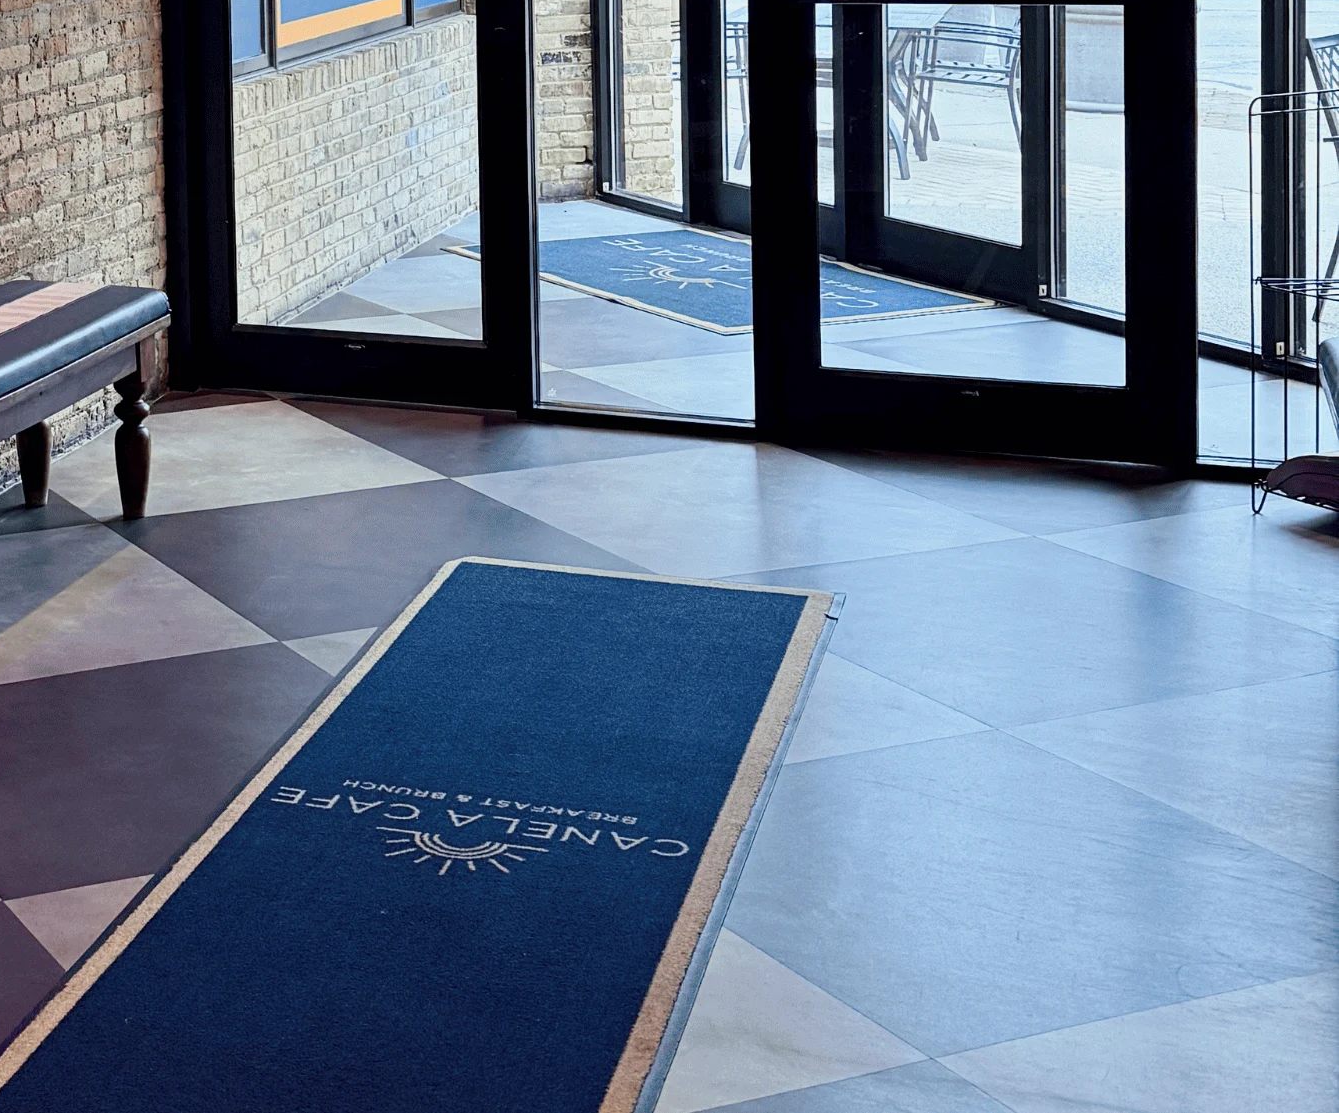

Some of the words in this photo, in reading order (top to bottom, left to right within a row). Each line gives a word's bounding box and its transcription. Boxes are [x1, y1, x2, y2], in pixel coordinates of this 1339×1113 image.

[270, 785, 421, 820] CAFE
[343, 779, 447, 800] BRUNCH
[479, 797, 638, 825] BREAKFAST
[445, 809, 690, 857] CANELA
